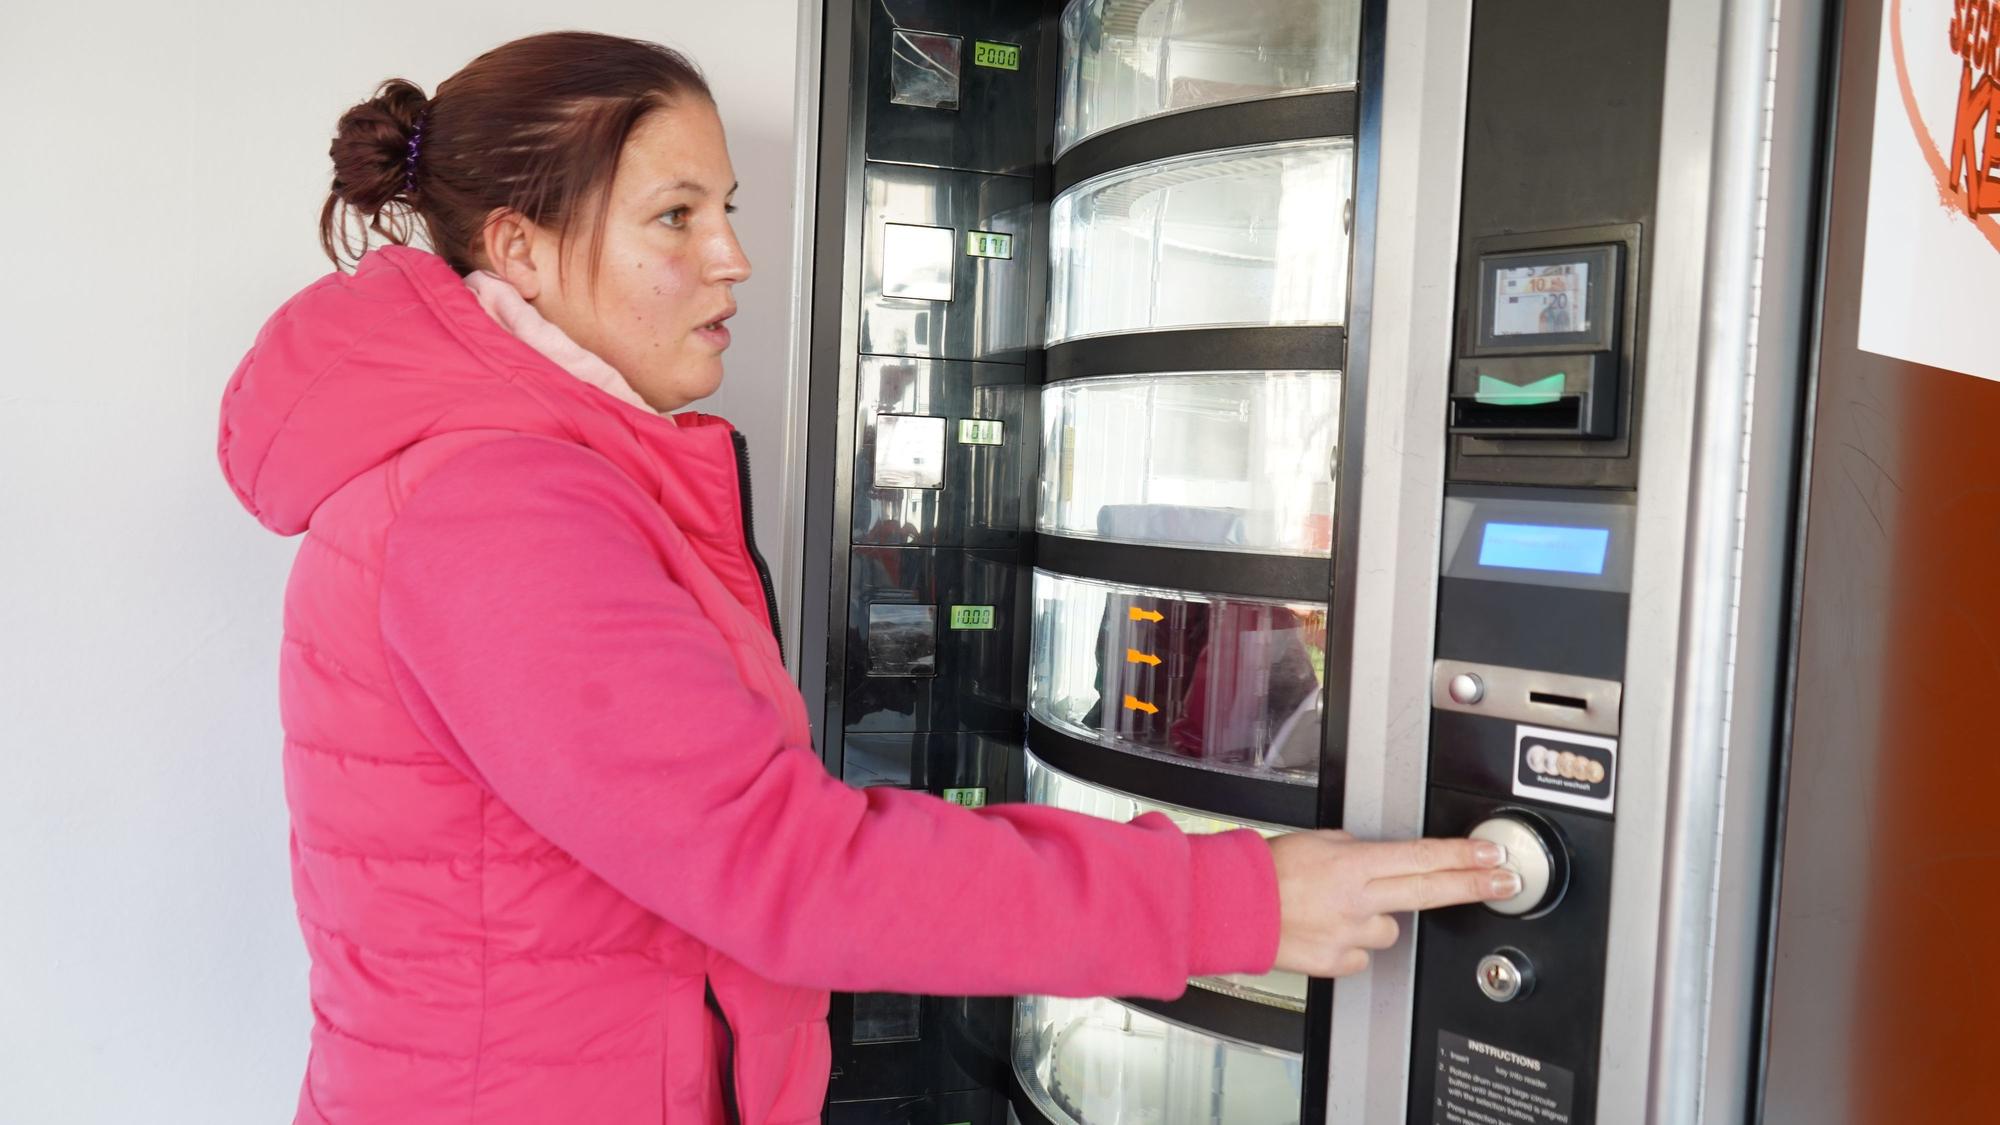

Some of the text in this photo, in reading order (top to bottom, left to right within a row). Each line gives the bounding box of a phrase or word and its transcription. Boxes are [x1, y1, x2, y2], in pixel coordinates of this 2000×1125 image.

[977, 46, 1016, 66] 20.00
[1549, 293, 1567, 309] 20
[957, 609, 990, 624] 10.00
[1468, 1039, 1541, 1071] INSTRUCTIONS
[1495, 1065, 1508, 1078] key
